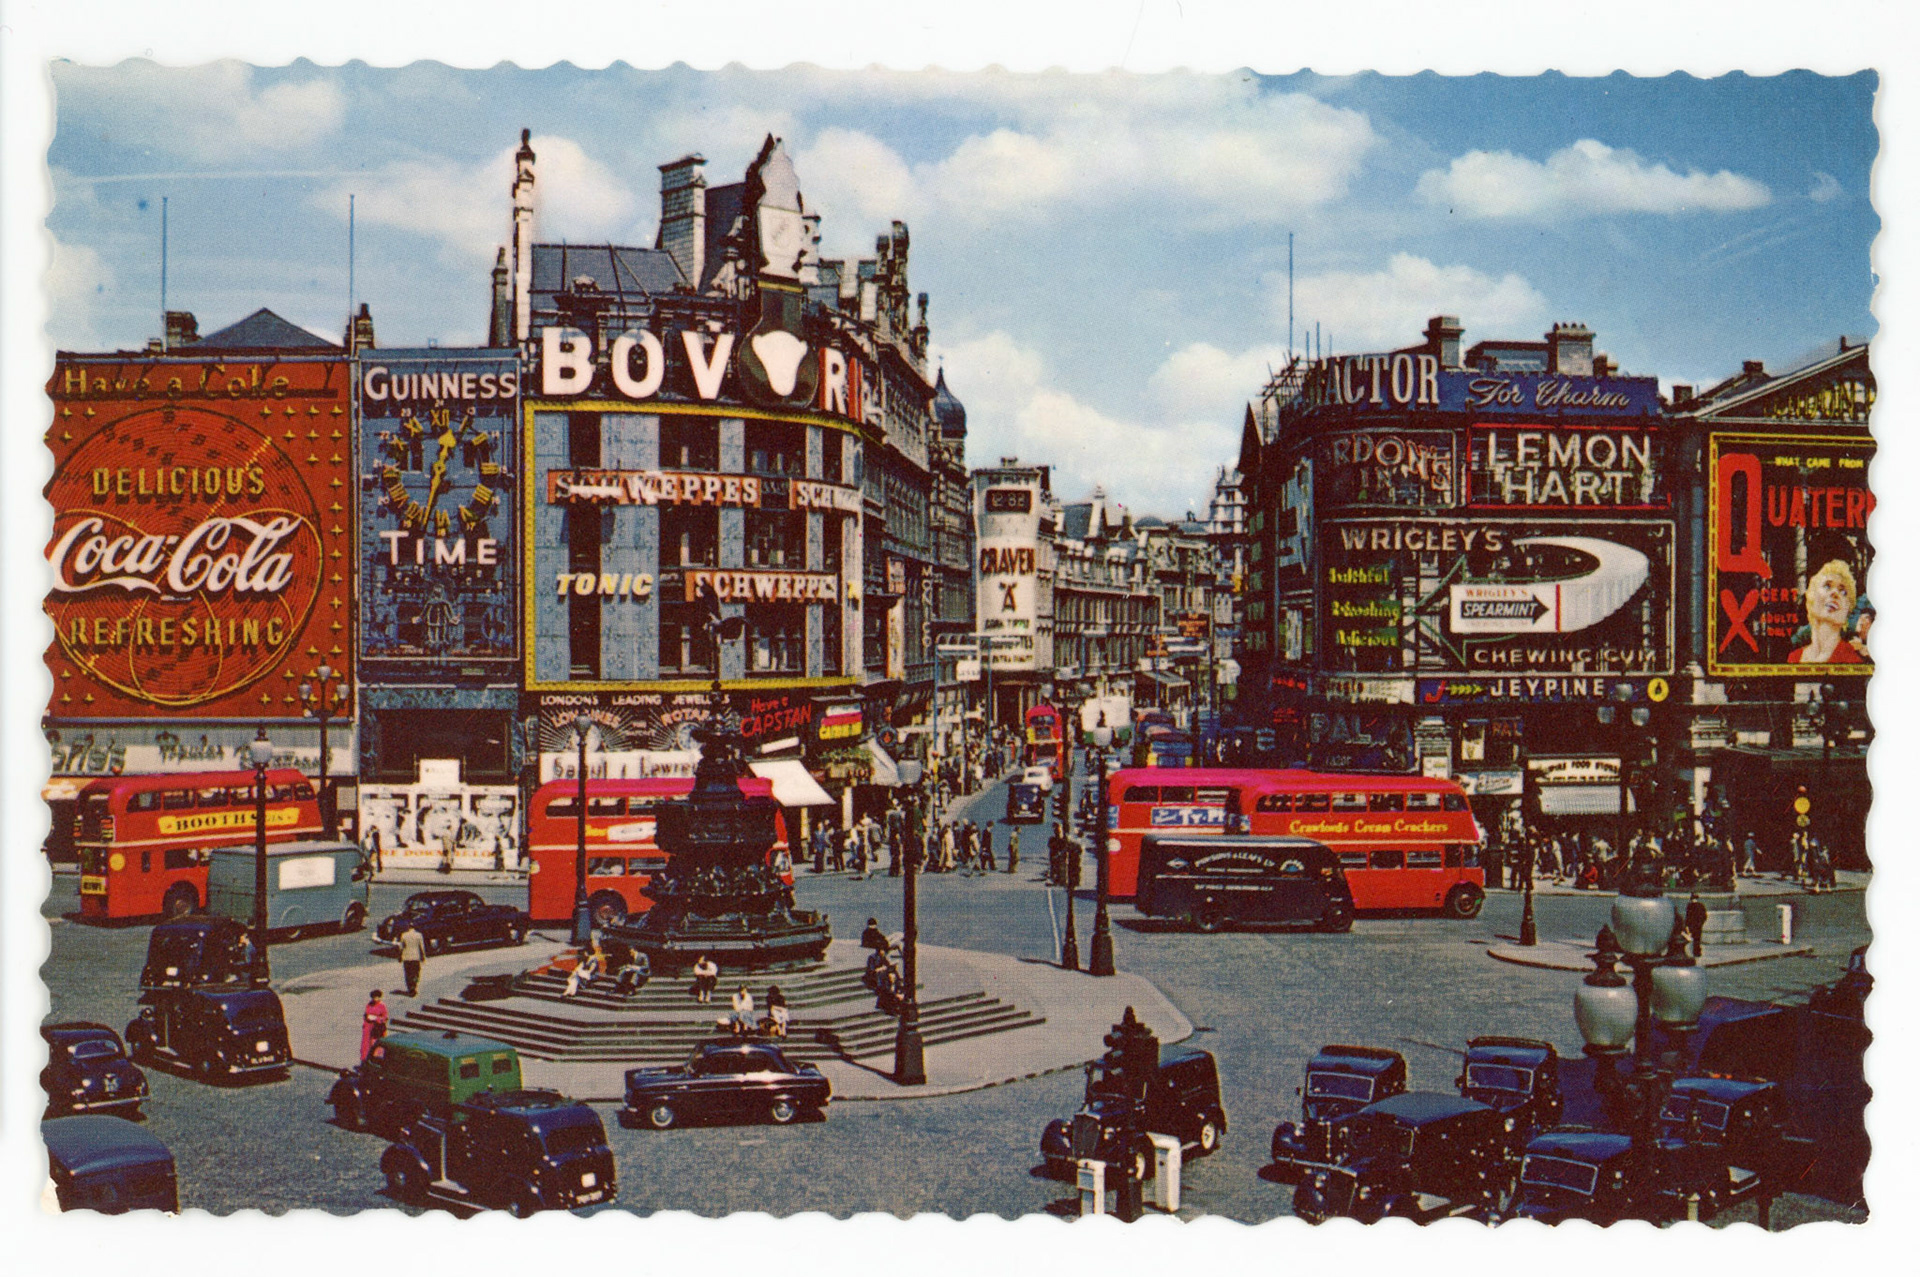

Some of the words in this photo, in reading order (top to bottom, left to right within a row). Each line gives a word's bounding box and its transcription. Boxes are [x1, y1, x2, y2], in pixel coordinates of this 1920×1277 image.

[167, 377, 183, 399] a
[199, 364, 290, 399] Coke
[364, 367, 517, 401] GUINNESS
[1467, 377, 1525, 406] For
[1535, 380, 1629, 407] Charm
[1488, 432, 1650, 469] LEMON
[1806, 458, 1831, 467] CAME
[1839, 459, 1864, 468] FROM
[93, 467, 265, 495] DELICIOUS
[555, 474, 758, 504] SCHWEPPES
[1504, 470, 1634, 505] HART
[379, 531, 498, 566] TIME
[1341, 525, 1503, 550] WRIGLEY'S
[48, 516, 305, 594] Coca-Cola
[980, 547, 1036, 575] CRAVEN
[556, 573, 654, 597] TONIC
[1760, 587, 1798, 602] CERT
[1463, 602, 1538, 616] SPEARMINT
[1719, 589, 1759, 653] X
[70, 617, 285, 646] REFRESHING
[1474, 649, 1592, 664] CHEWING
[1602, 649, 1657, 665] GUM
[540, 694, 599, 706] LONDON'S
[612, 694, 663, 705] LEADING
[671, 694, 730, 706] JEWELLS
[1490, 679, 1605, 697] JEYPINE
[740, 703, 812, 737] CAPSTAN
[1395, 818, 1449, 833] Crackers
